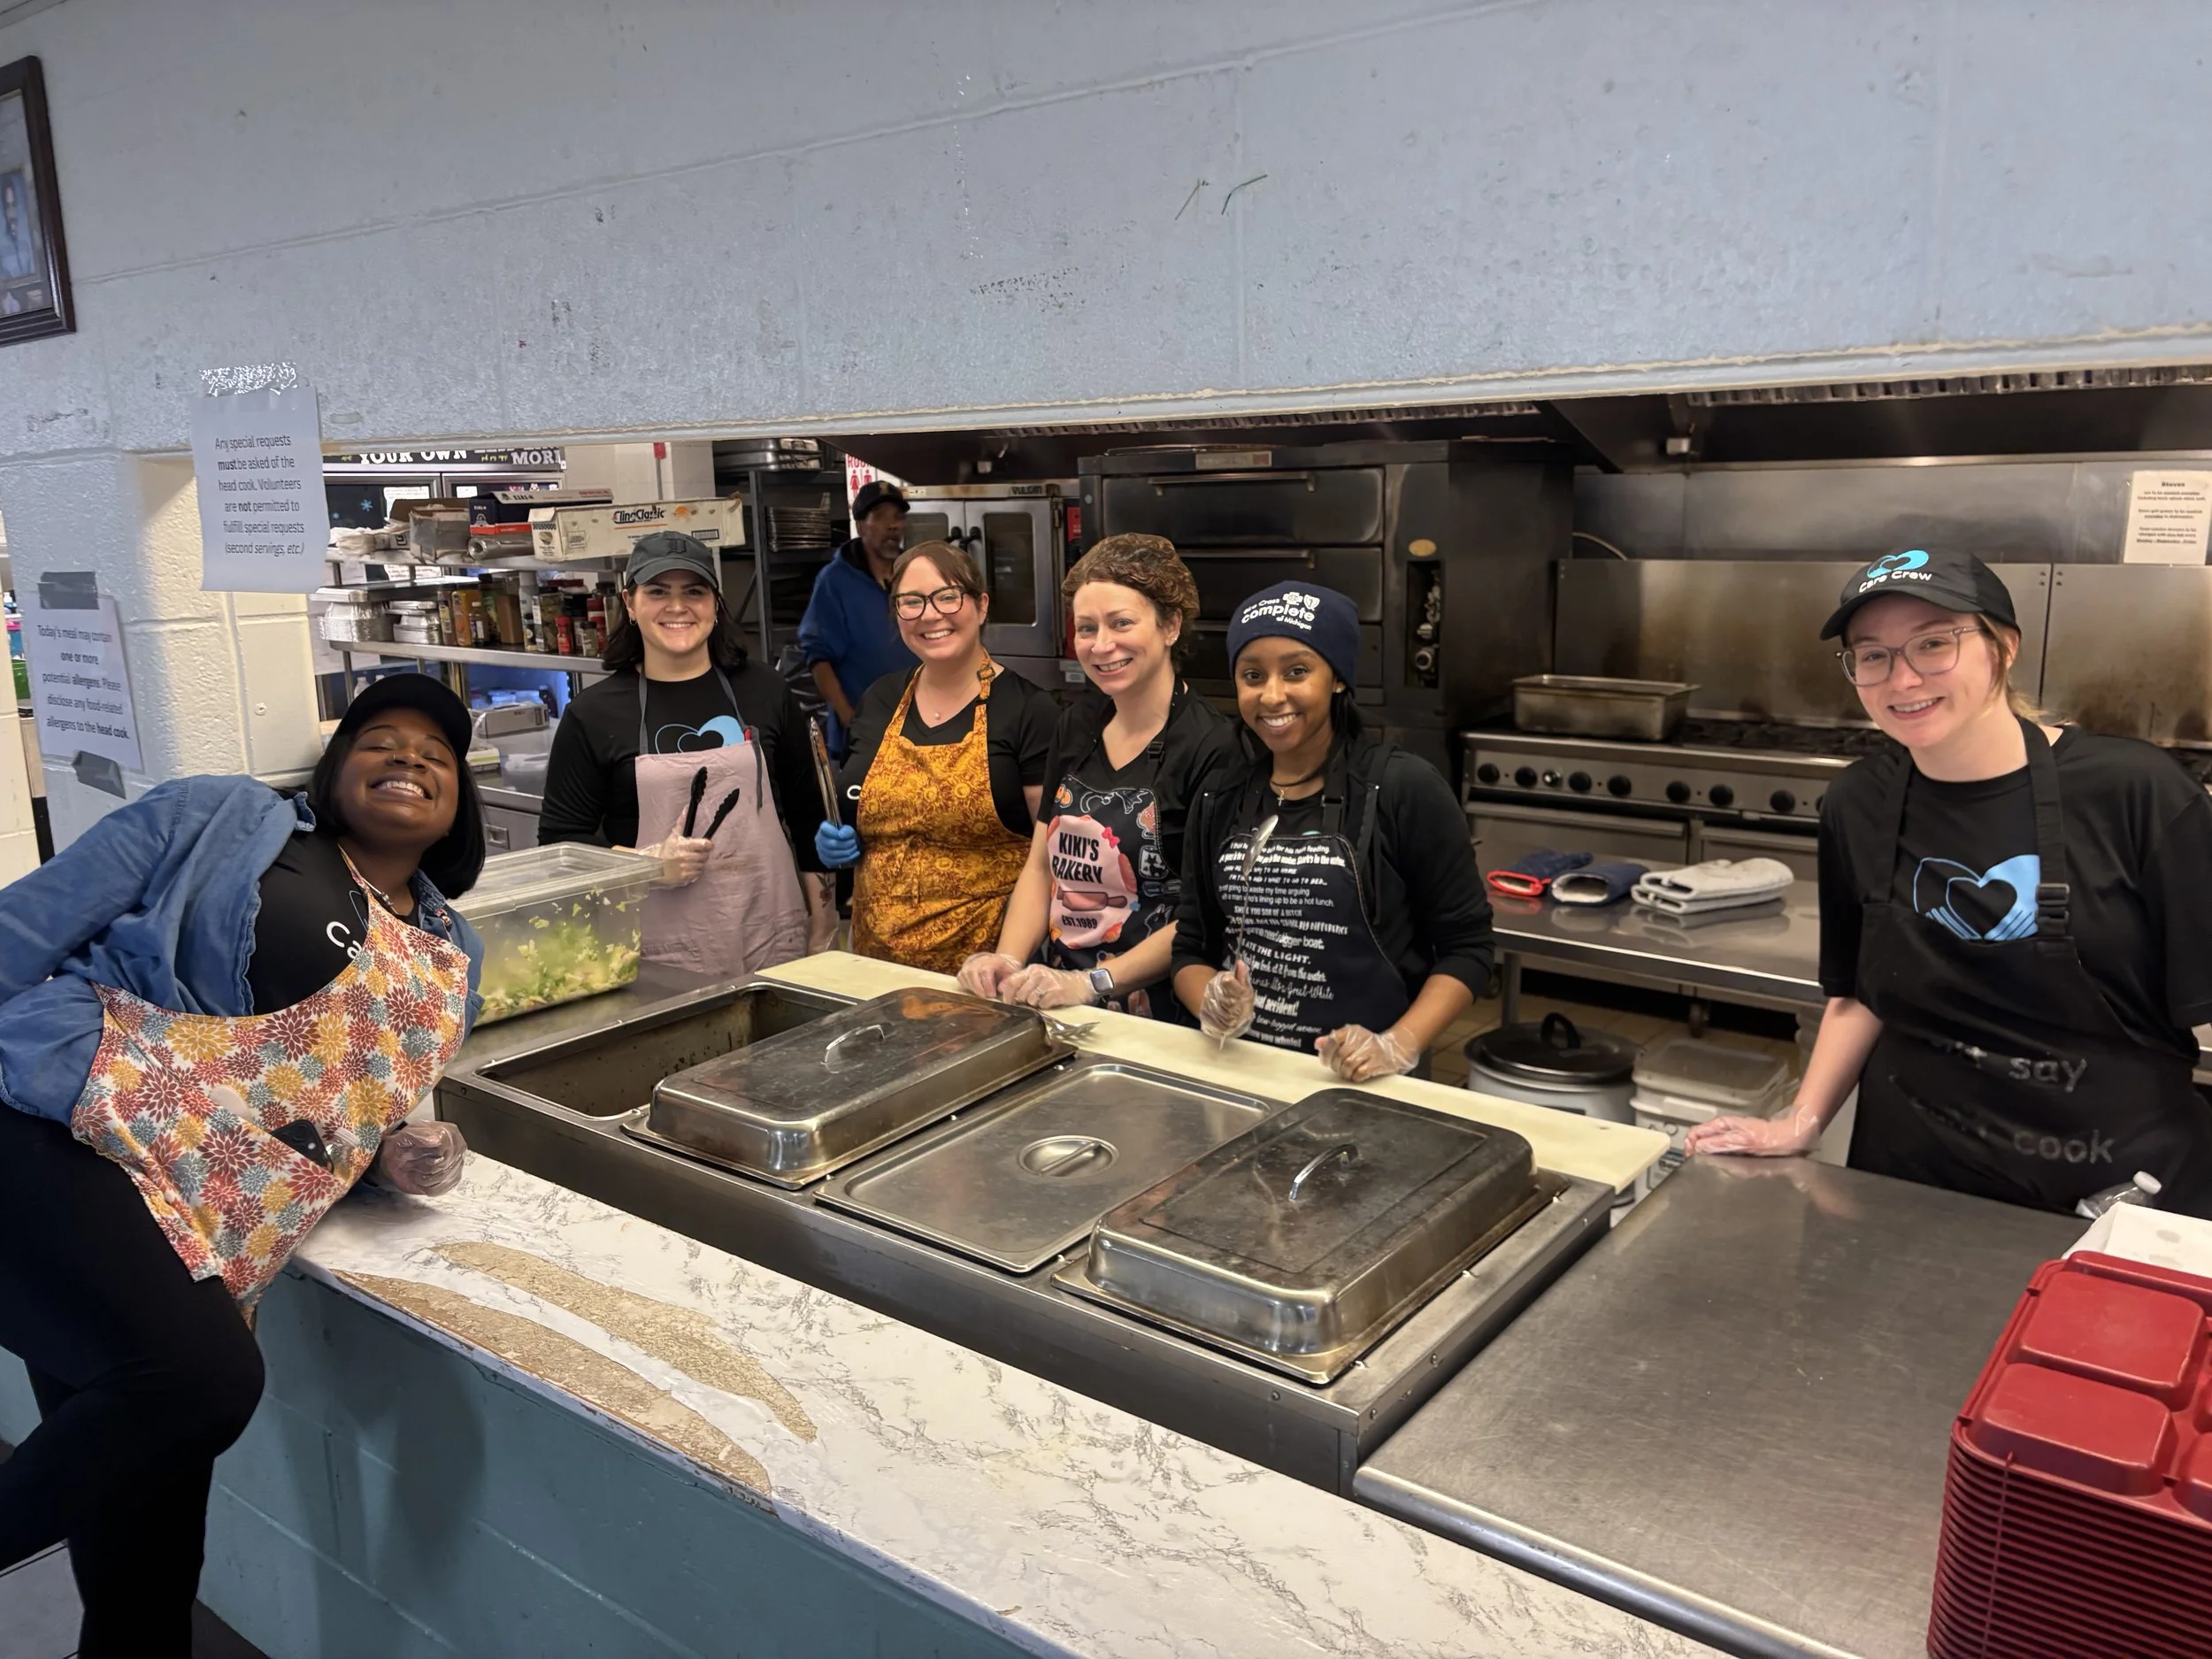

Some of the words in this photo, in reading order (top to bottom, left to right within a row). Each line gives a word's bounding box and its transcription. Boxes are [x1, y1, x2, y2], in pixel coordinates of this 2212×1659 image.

[215, 438, 229, 452] Any
[230, 436, 255, 451] special
[256, 434, 291, 449] requests
[218, 459, 238, 471] must
[238, 459, 246, 469] be
[249, 457, 270, 469] asked
[271, 456, 280, 468] of
[280, 456, 295, 468] the
[219, 480, 236, 491] head
[239, 480, 257, 491] cook.
[257, 479, 302, 490] Volunteers
[224, 503, 237, 511] are
[238, 501, 251, 511] not
[253, 500, 289, 513] permitted
[291, 501, 299, 511] to
[244, 521, 269, 535] special
[271, 522, 304, 535] requests
[225, 542, 253, 555] (second
[255, 541, 285, 557] servings,
[287, 542, 304, 555] etc.)
[1859, 575, 1887, 593] Care
[1892, 571, 1932, 581] Crew
[1258, 598, 1279, 607] Cross
[1240, 603, 1315, 624] complete
[1284, 617, 1312, 630] Michigan
[60, 652, 73, 662] one
[74, 653, 81, 662] or
[82, 655, 99, 664] more
[48, 694, 73, 707] disclose
[46, 716, 76, 731] allergens
[76, 722, 84, 731] to
[85, 721, 96, 733] the
[97, 723, 112, 736] head
[113, 727, 131, 739] cook.
[1059, 832, 1099, 862] KIKI'S
[1307, 846, 1330, 855] feeding.
[1051, 855, 1102, 884] BAKERY
[1287, 887, 1310, 897] arguing
[1258, 895, 1274, 905] lining
[1315, 897, 1335, 907] lunch.
[1062, 915, 1097, 929] EST.1989
[1302, 935, 1325, 949] boat.
[1246, 941, 1256, 952] ATE
[1256, 945, 1272, 957] THE
[1274, 950, 1311, 964] LIGHT.
[1297, 966, 1307, 979] the
[1264, 996, 1300, 1016] accident!
[2008, 1057, 2088, 1093] say
[2014, 1129, 2116, 1164] cook
